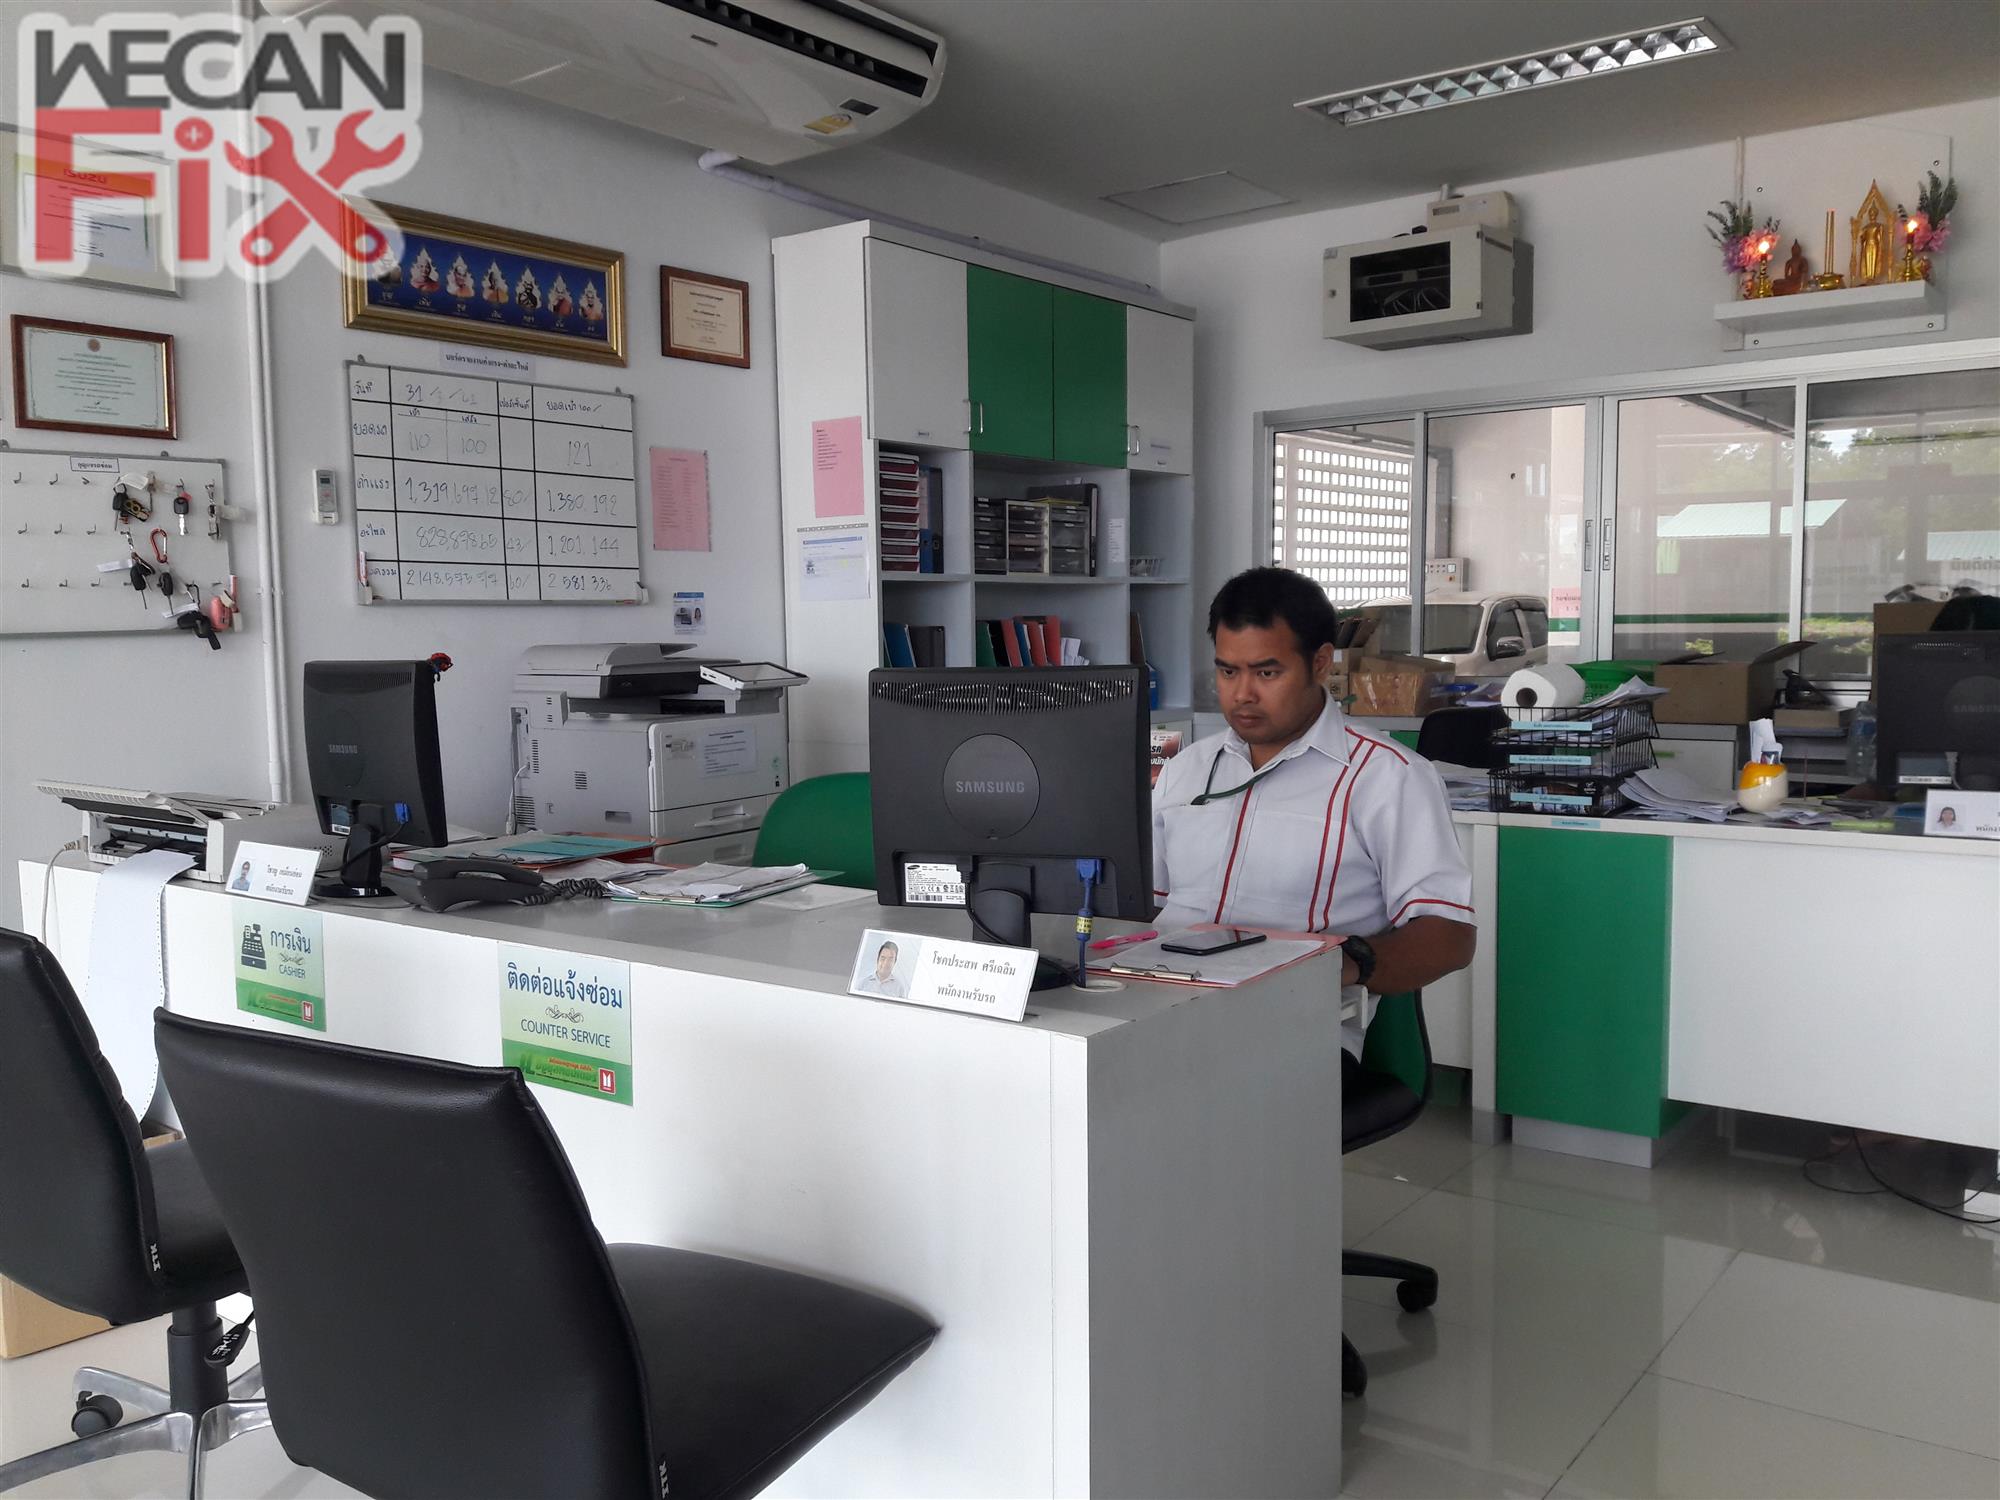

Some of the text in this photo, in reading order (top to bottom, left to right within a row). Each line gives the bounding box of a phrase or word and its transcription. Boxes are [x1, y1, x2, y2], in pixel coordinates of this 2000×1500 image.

[955, 780, 1025, 793] SAMSUNG
[270, 927, 312, 955] การเงิน
[279, 964, 307, 979] CASHIER
[507, 961, 623, 1009] ติดต่อแจ้งซ่อม
[937, 983, 996, 1005] พนักงานรับรถ
[520, 1018, 612, 1049] COUNTER SERVICE
